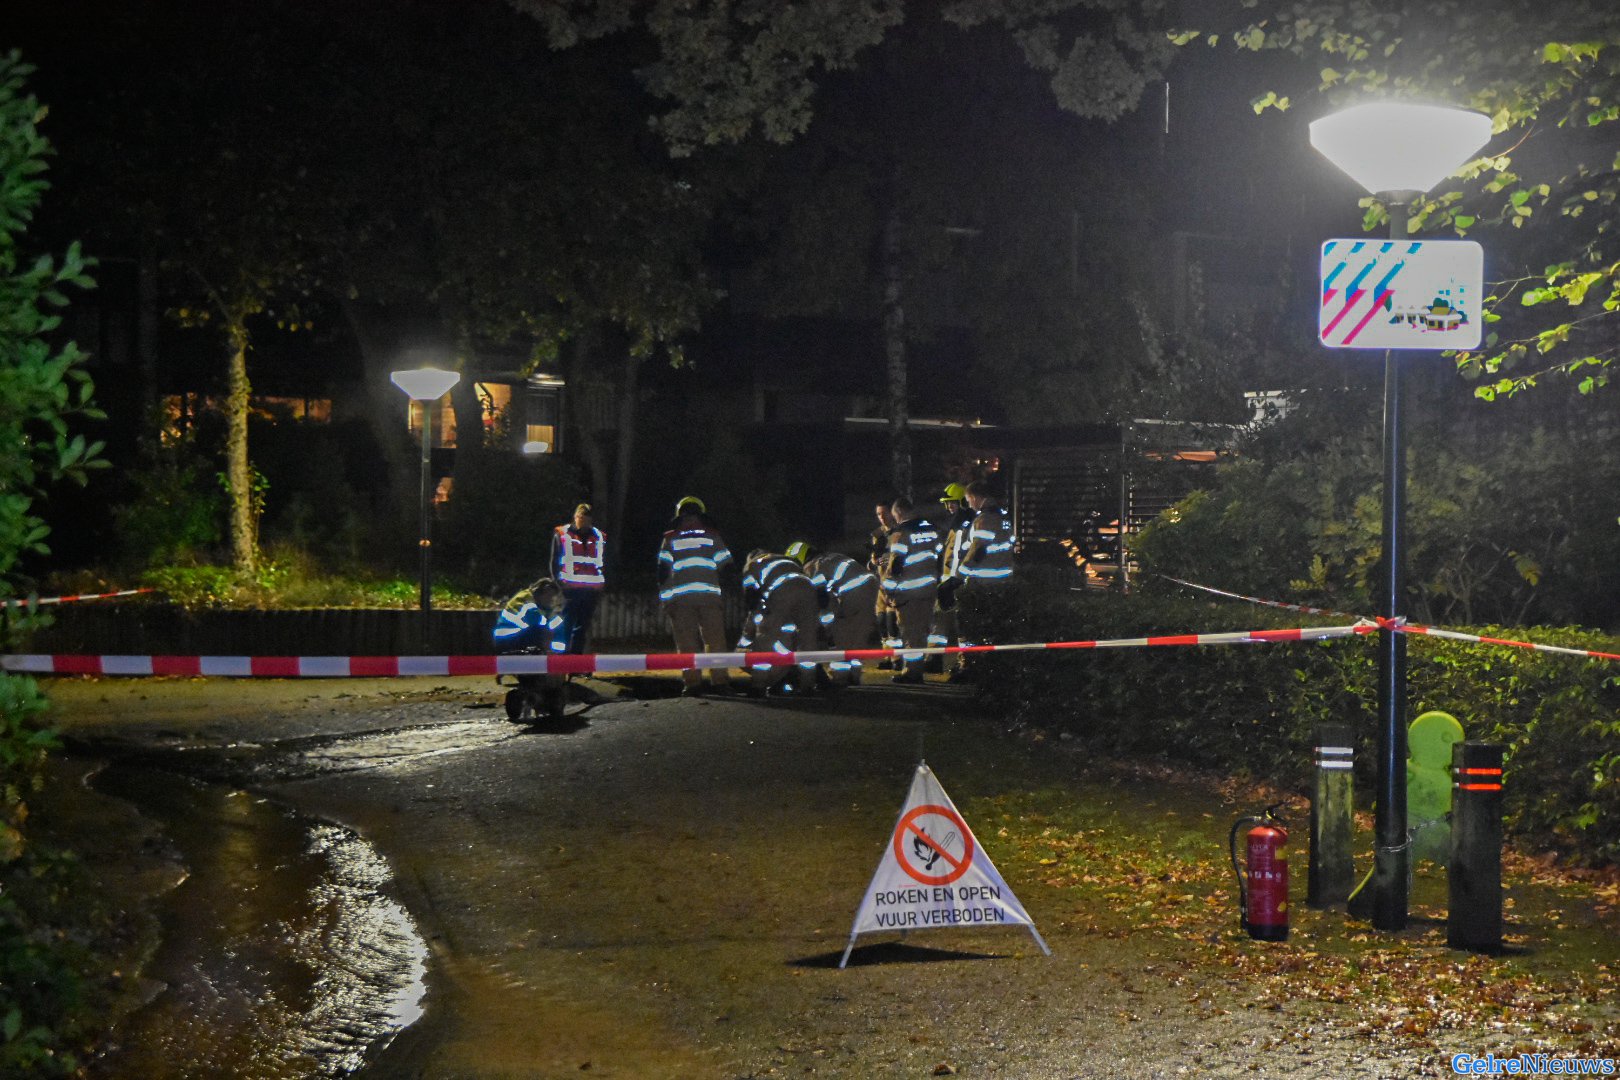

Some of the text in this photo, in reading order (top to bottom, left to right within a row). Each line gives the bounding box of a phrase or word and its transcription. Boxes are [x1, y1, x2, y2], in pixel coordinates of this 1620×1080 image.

[875, 886, 1001, 906] ROKEN EN OPEN
[875, 908, 1005, 927] VUUR VERBODEN
